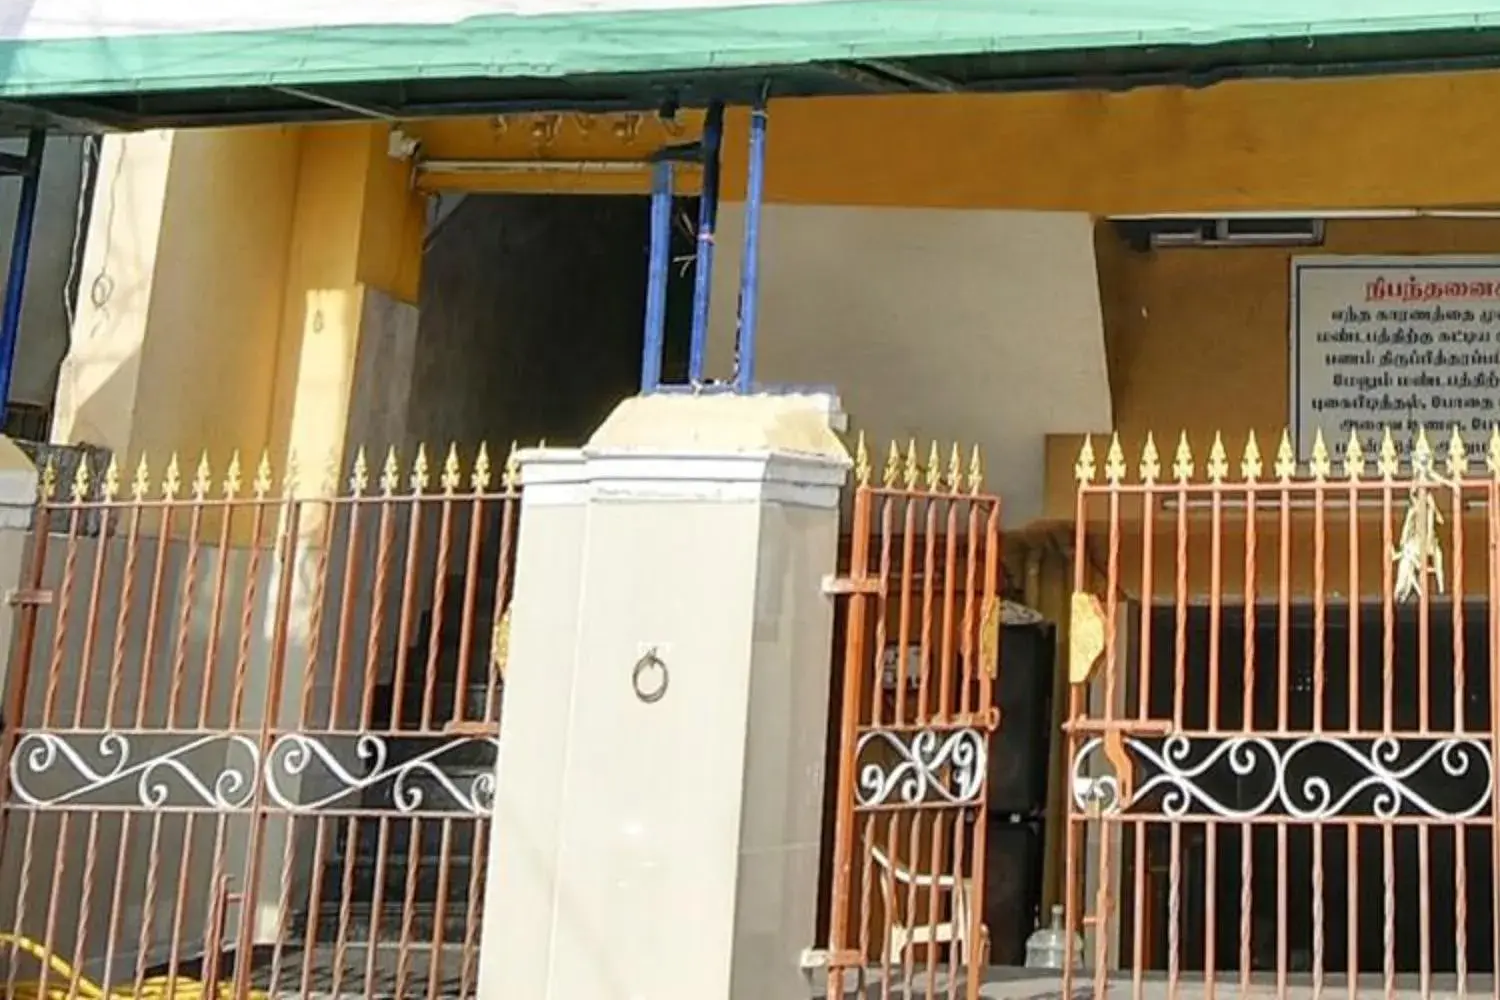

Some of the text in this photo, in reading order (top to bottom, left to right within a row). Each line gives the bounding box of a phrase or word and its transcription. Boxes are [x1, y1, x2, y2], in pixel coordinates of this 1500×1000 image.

[1331, 306, 1371, 323] எந்த
[1376, 306, 1475, 323] காரணத்தை
[1316, 327, 1434, 345] மண்டபத்திற்கு
[1325, 349, 1374, 366] பணம்
[1333, 371, 1393, 390] மேலும்
[1431, 395, 1496, 410] போதை
